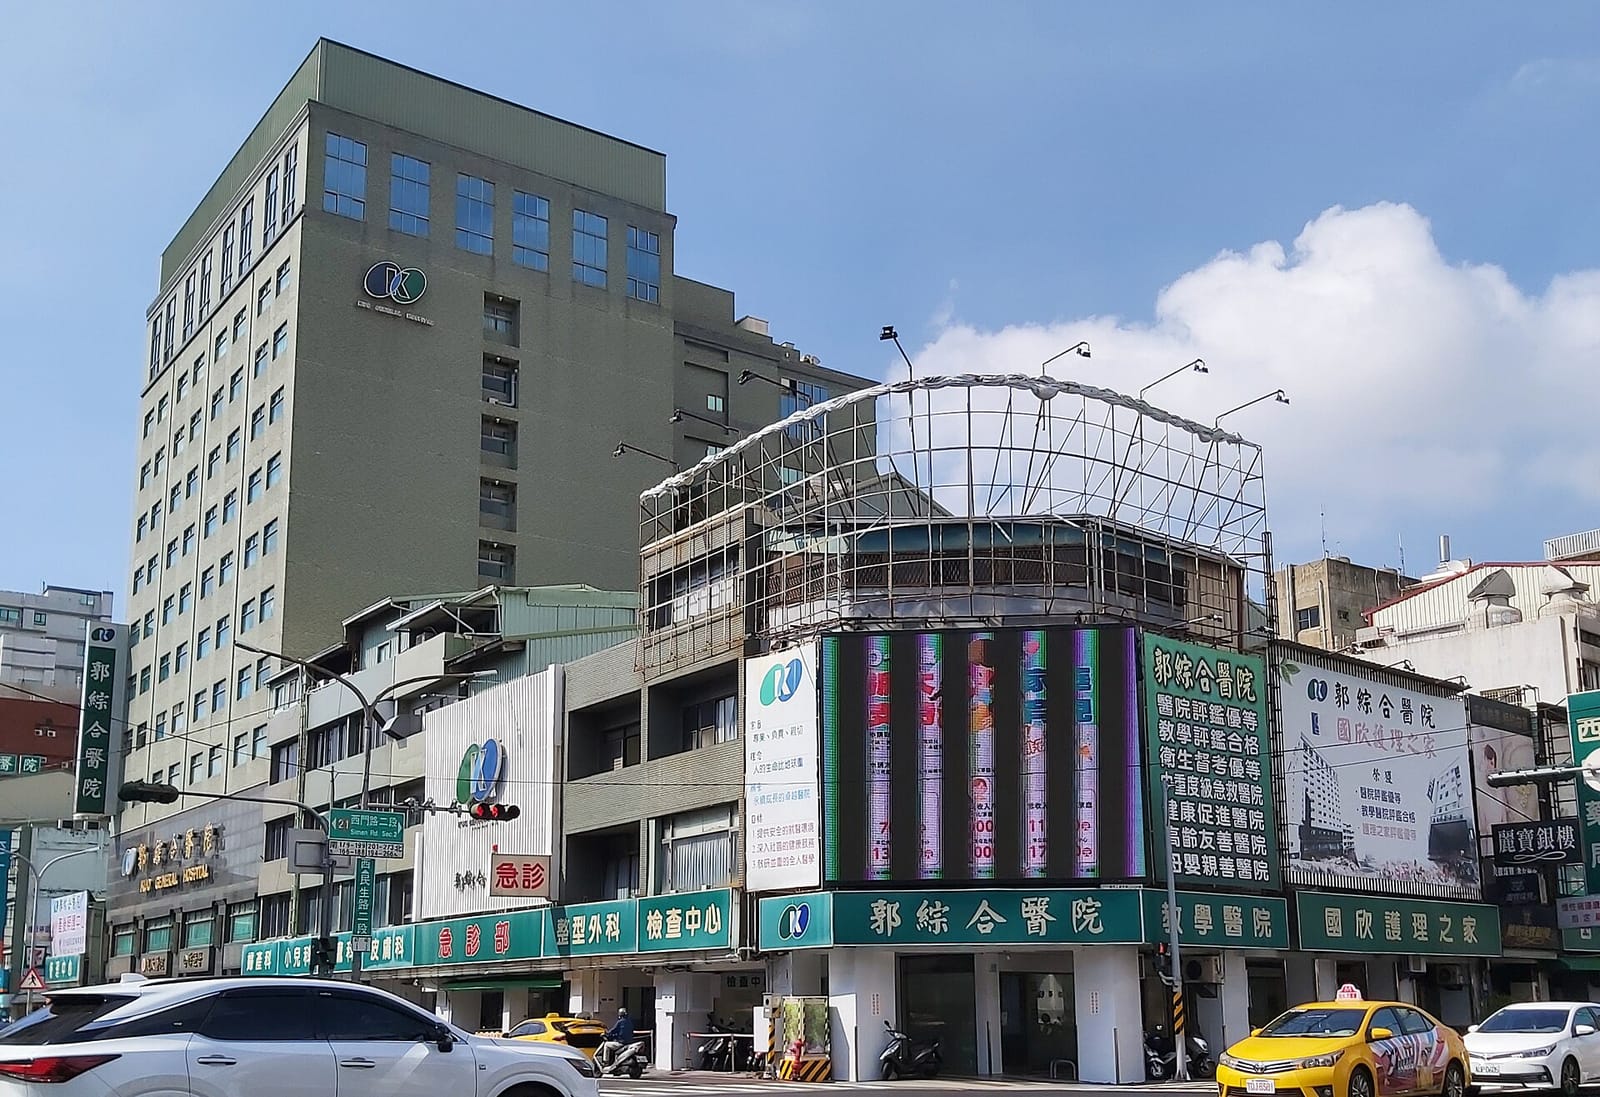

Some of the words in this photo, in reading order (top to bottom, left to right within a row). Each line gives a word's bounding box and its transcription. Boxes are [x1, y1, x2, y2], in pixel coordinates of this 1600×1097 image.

[1154, 647, 1256, 702] 郭綜合醫院
[1157, 693, 1258, 732] 醫院評鑑優等
[1334, 681, 1436, 729] 郭綜合醫院
[82, 660, 110, 798] 郭綜合醫院
[1158, 719, 1259, 756] 教學評鑑合格
[1337, 717, 1438, 760] 國欣護理之家
[1159, 745, 1261, 780] 衛生督考優等
[350, 814, 398, 828] 西門路二段
[1498, 825, 1576, 853] 麗寶銀樓
[495, 862, 545, 889] 急診
[556, 911, 621, 946] 整型外科
[646, 902, 721, 940] 檢查中心
[870, 896, 1105, 937] 郭綜合醫院
[1324, 906, 1479, 944] 國欣護理之家
[370, 935, 404, 962] 皮膚科
[438, 920, 510, 960] 急診部
